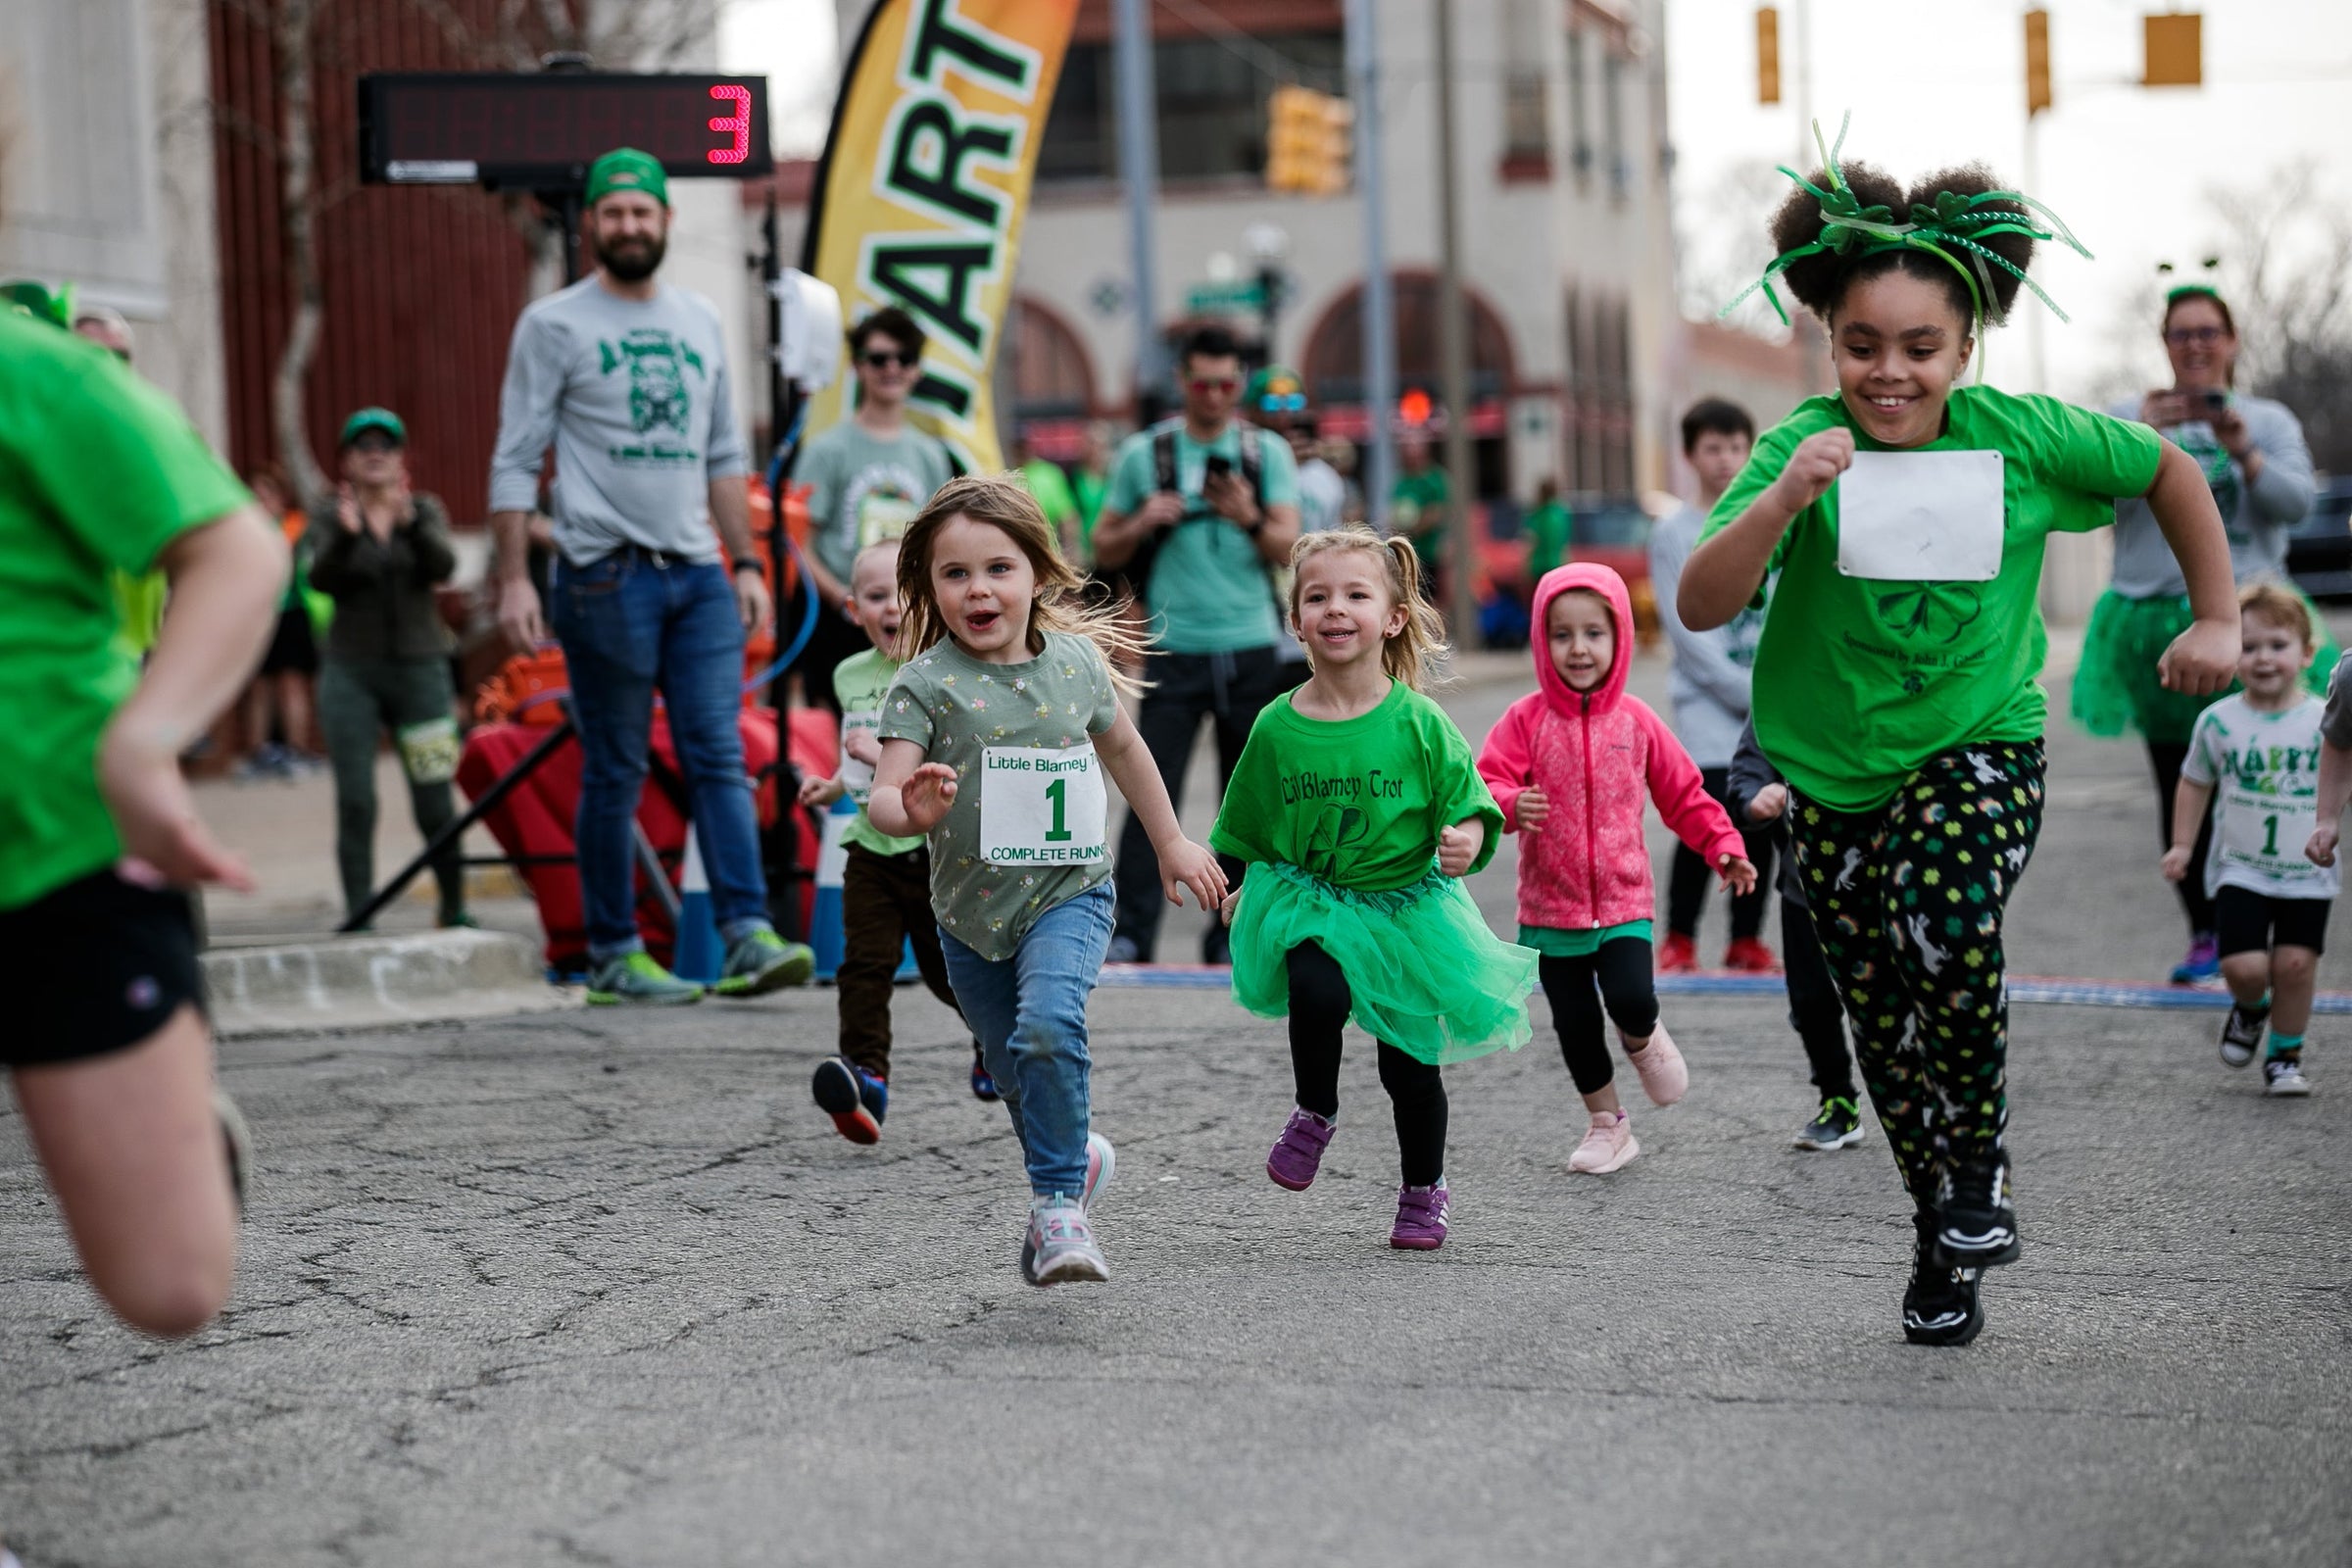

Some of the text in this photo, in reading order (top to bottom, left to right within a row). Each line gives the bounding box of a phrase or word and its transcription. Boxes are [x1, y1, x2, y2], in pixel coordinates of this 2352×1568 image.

[707, 84, 752, 164] 3
[853, 0, 1029, 478] ART
[988, 756, 1031, 771] Little
[1035, 757, 1088, 772] Blarney
[1300, 770, 1361, 803] Blarney
[1368, 769, 1404, 799] Trot
[1045, 778, 1072, 842] 1
[991, 847, 1066, 861] COMPLETE
[2260, 814, 2279, 857] 1
